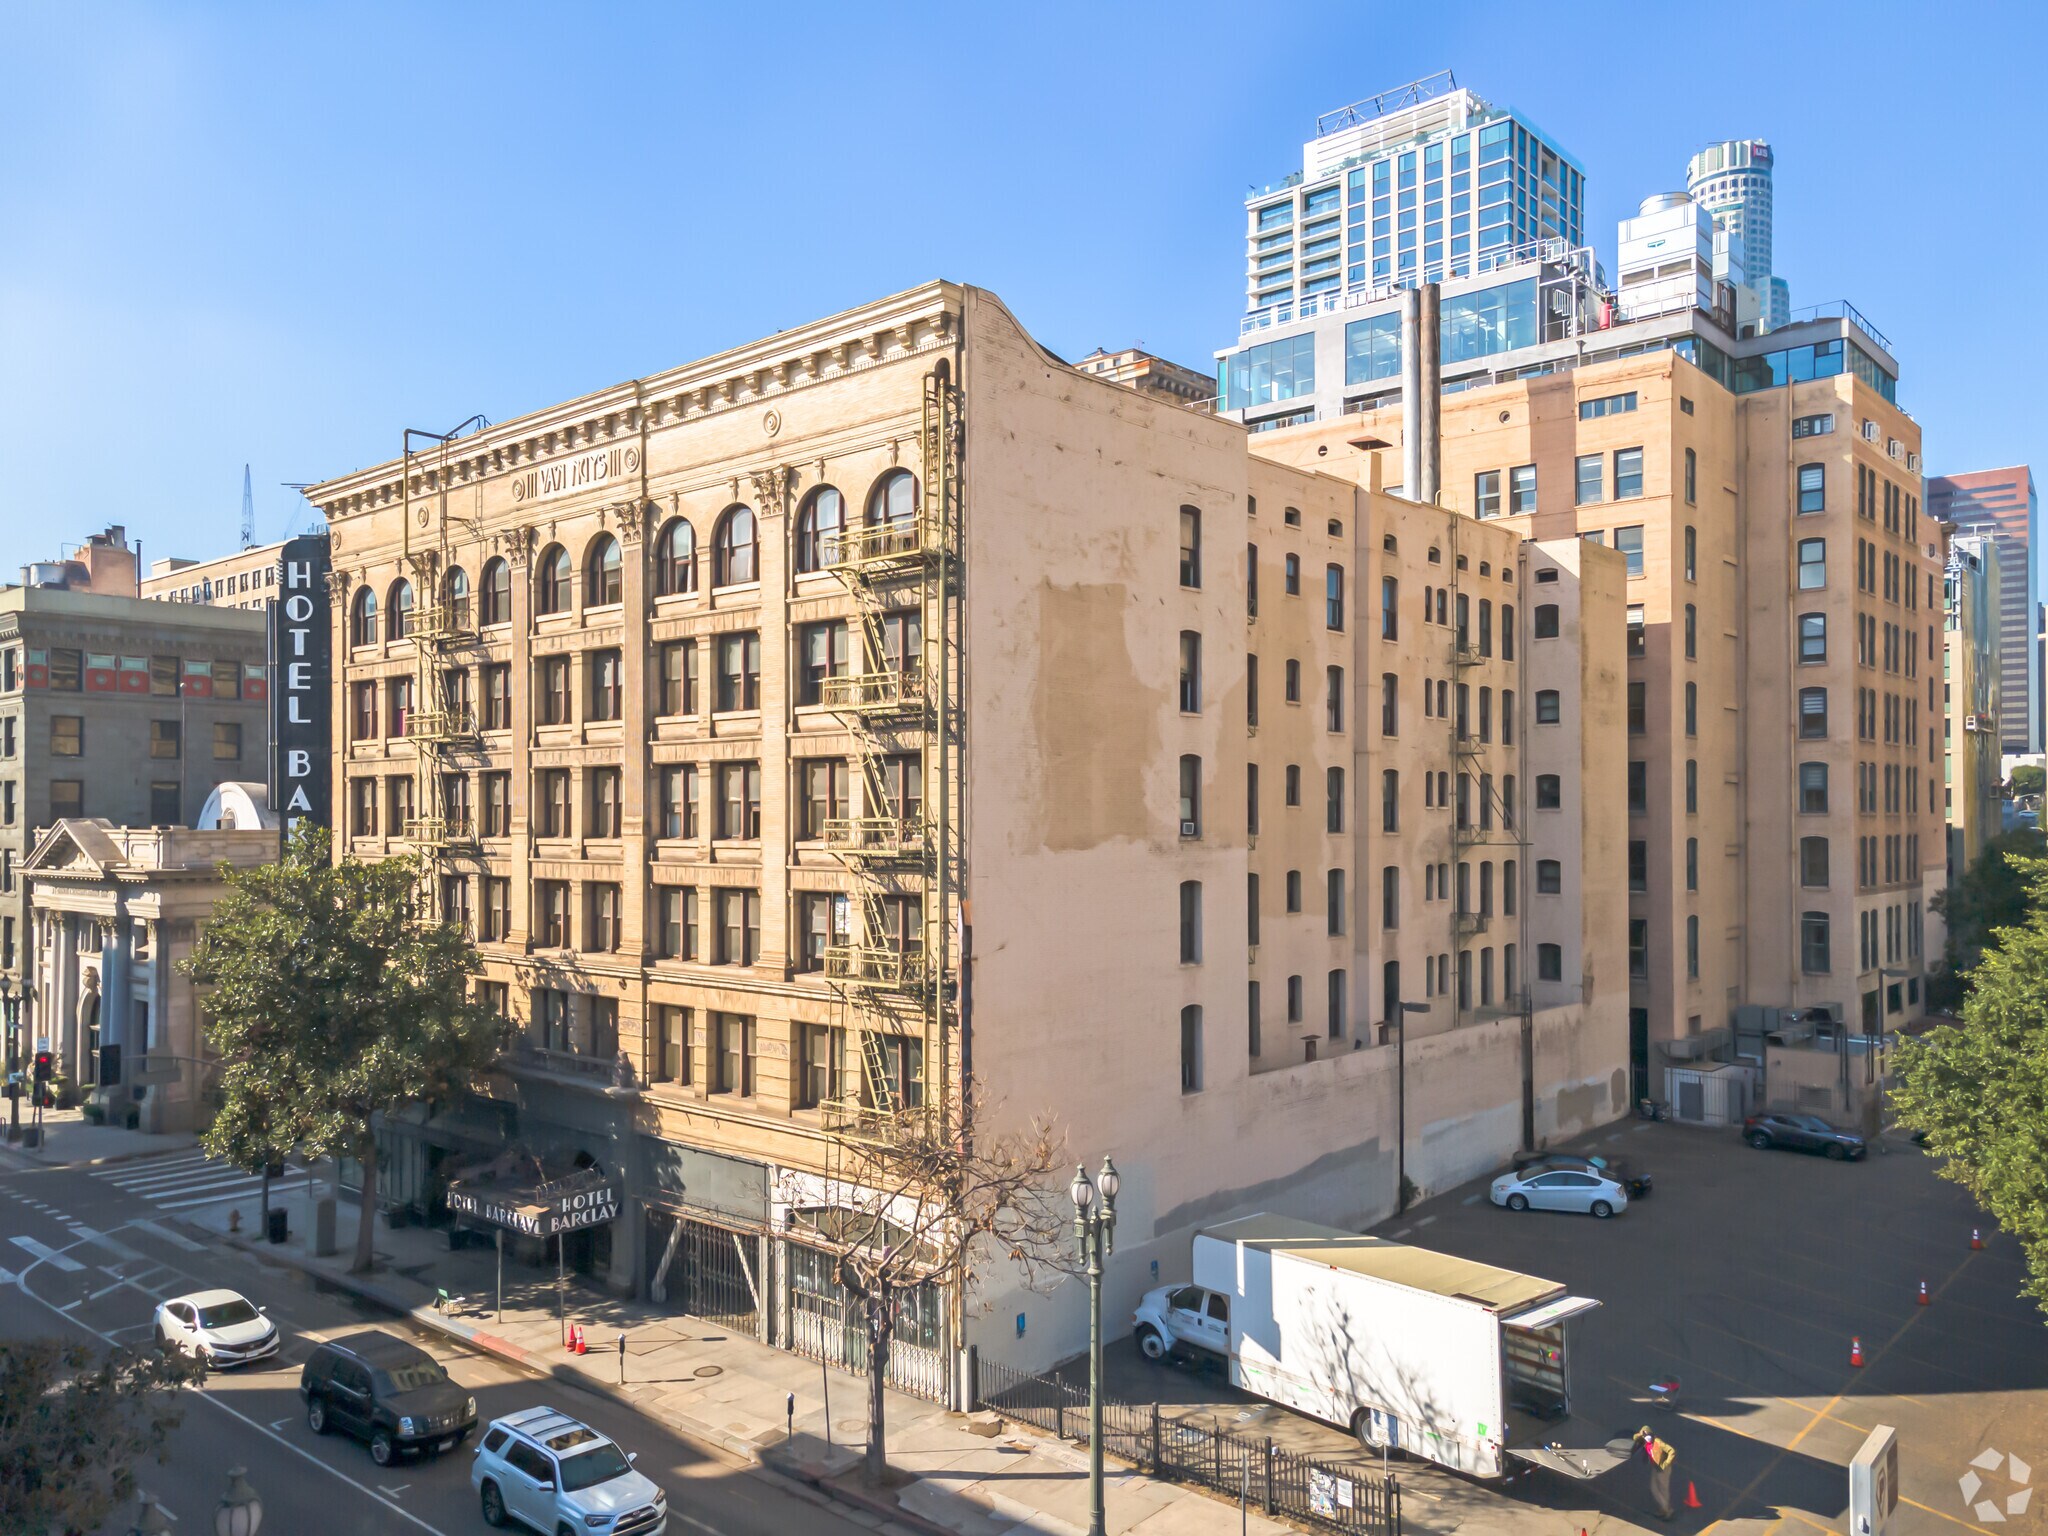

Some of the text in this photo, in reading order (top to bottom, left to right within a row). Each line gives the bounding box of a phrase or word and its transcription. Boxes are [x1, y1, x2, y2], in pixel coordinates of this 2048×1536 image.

[285, 561, 314, 724] HOTEL
[562, 1188, 614, 1213] HOTEL
[551, 1201, 619, 1232] BARCLAY
